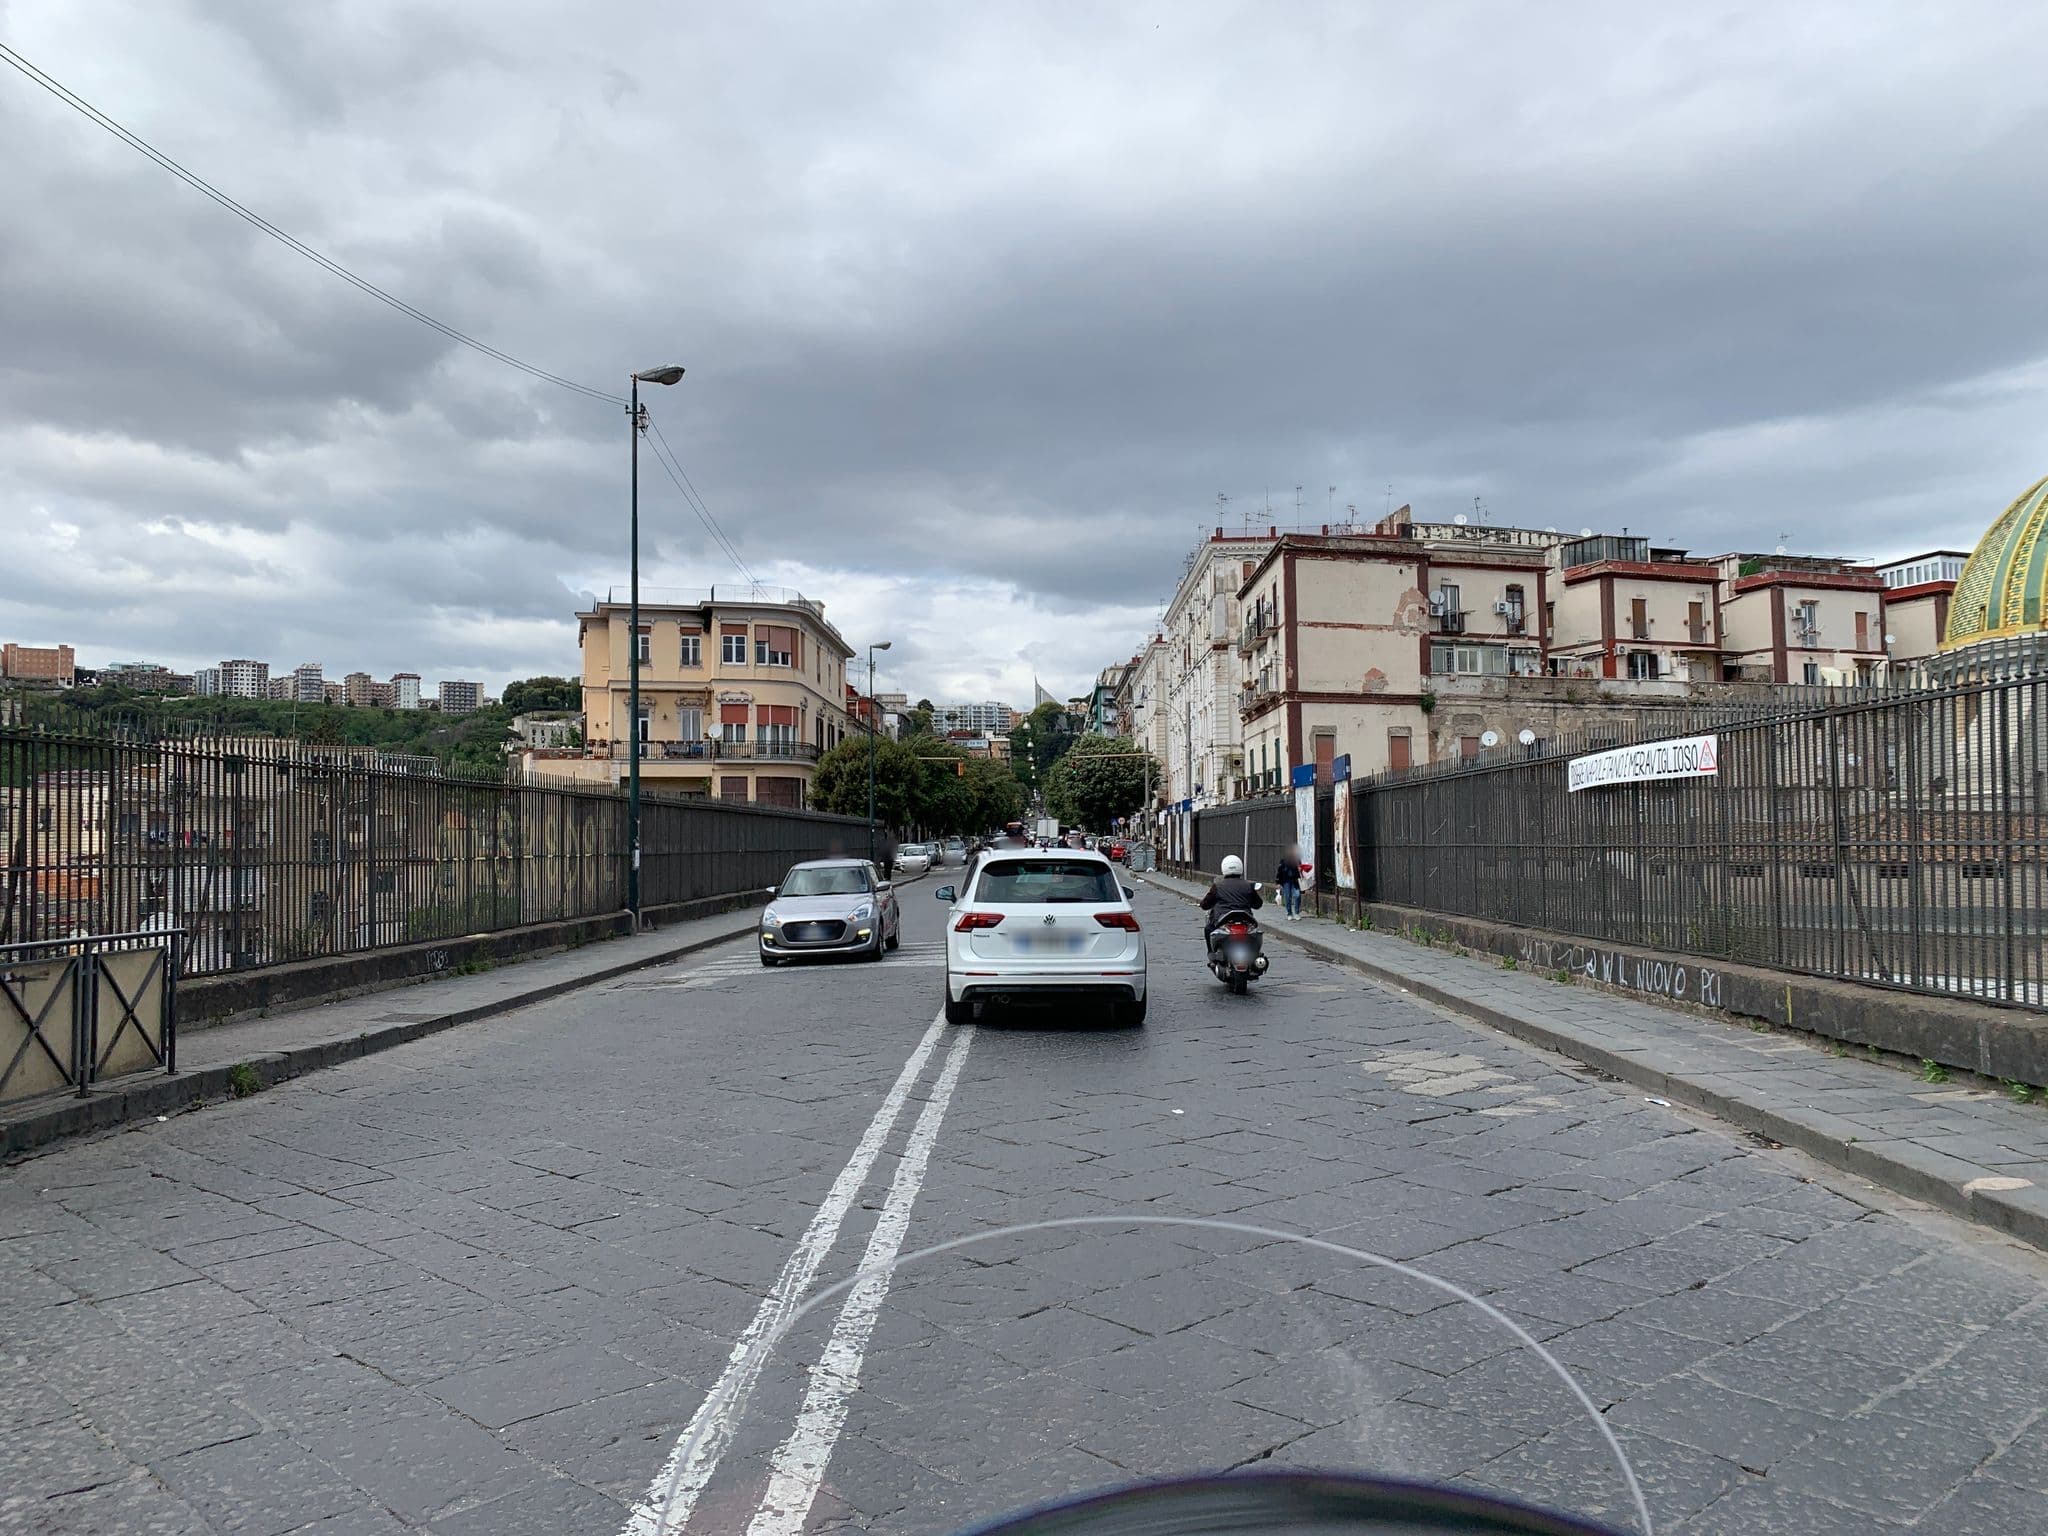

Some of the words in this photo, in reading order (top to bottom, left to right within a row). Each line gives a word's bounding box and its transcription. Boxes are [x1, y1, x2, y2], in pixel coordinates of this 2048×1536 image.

[1628, 744, 1698, 776] MERAVIGLIOSO
[1636, 958, 1687, 996] NUOVO
[1701, 967, 1721, 1006] PCI
